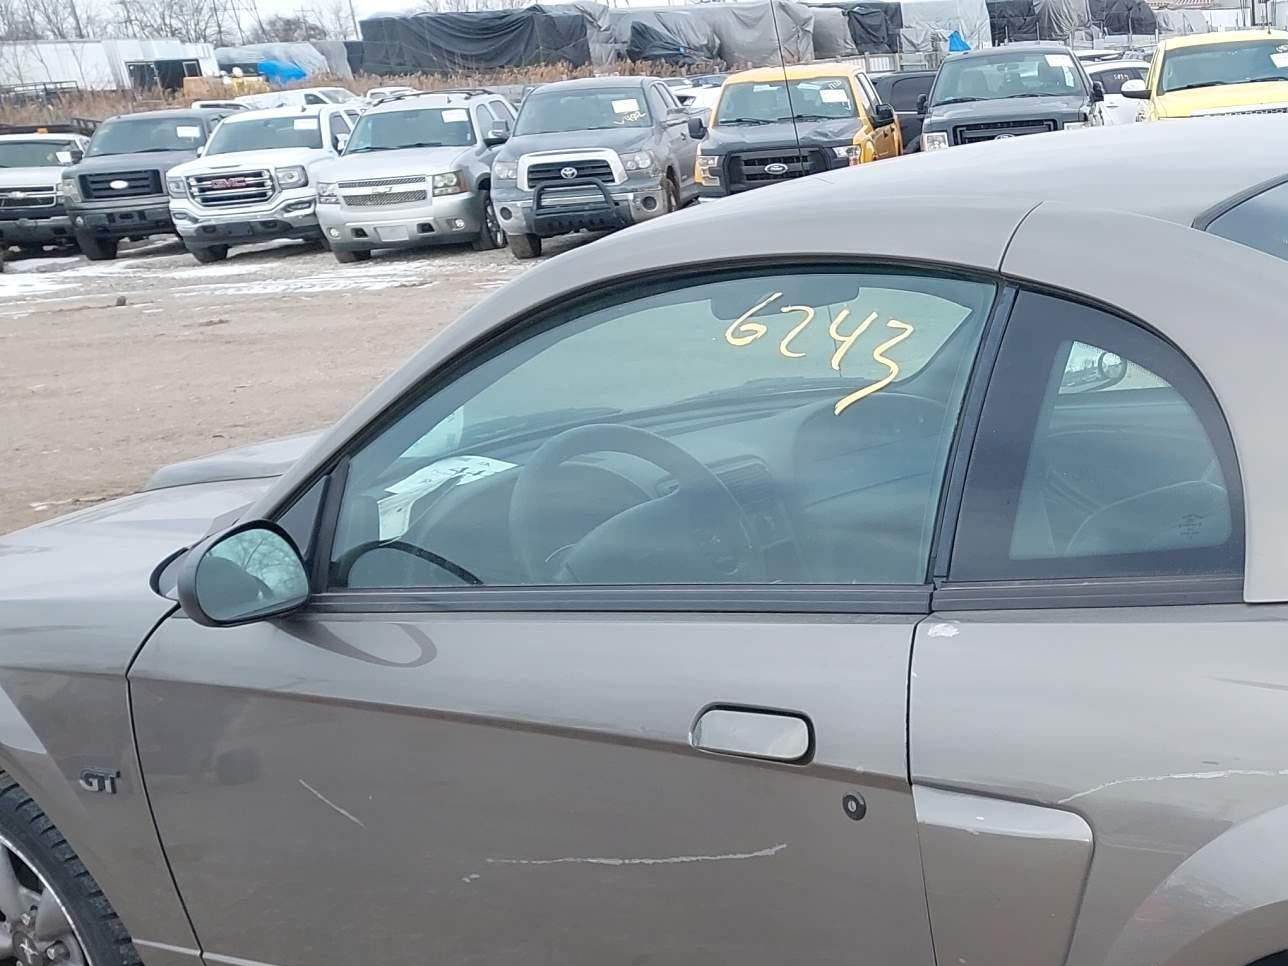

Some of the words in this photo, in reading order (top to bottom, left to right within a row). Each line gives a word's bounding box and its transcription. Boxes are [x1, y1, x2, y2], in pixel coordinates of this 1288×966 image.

[210, 177, 246, 189] GMC
[724, 291, 915, 416] 6243
[80, 767, 121, 794] GT
